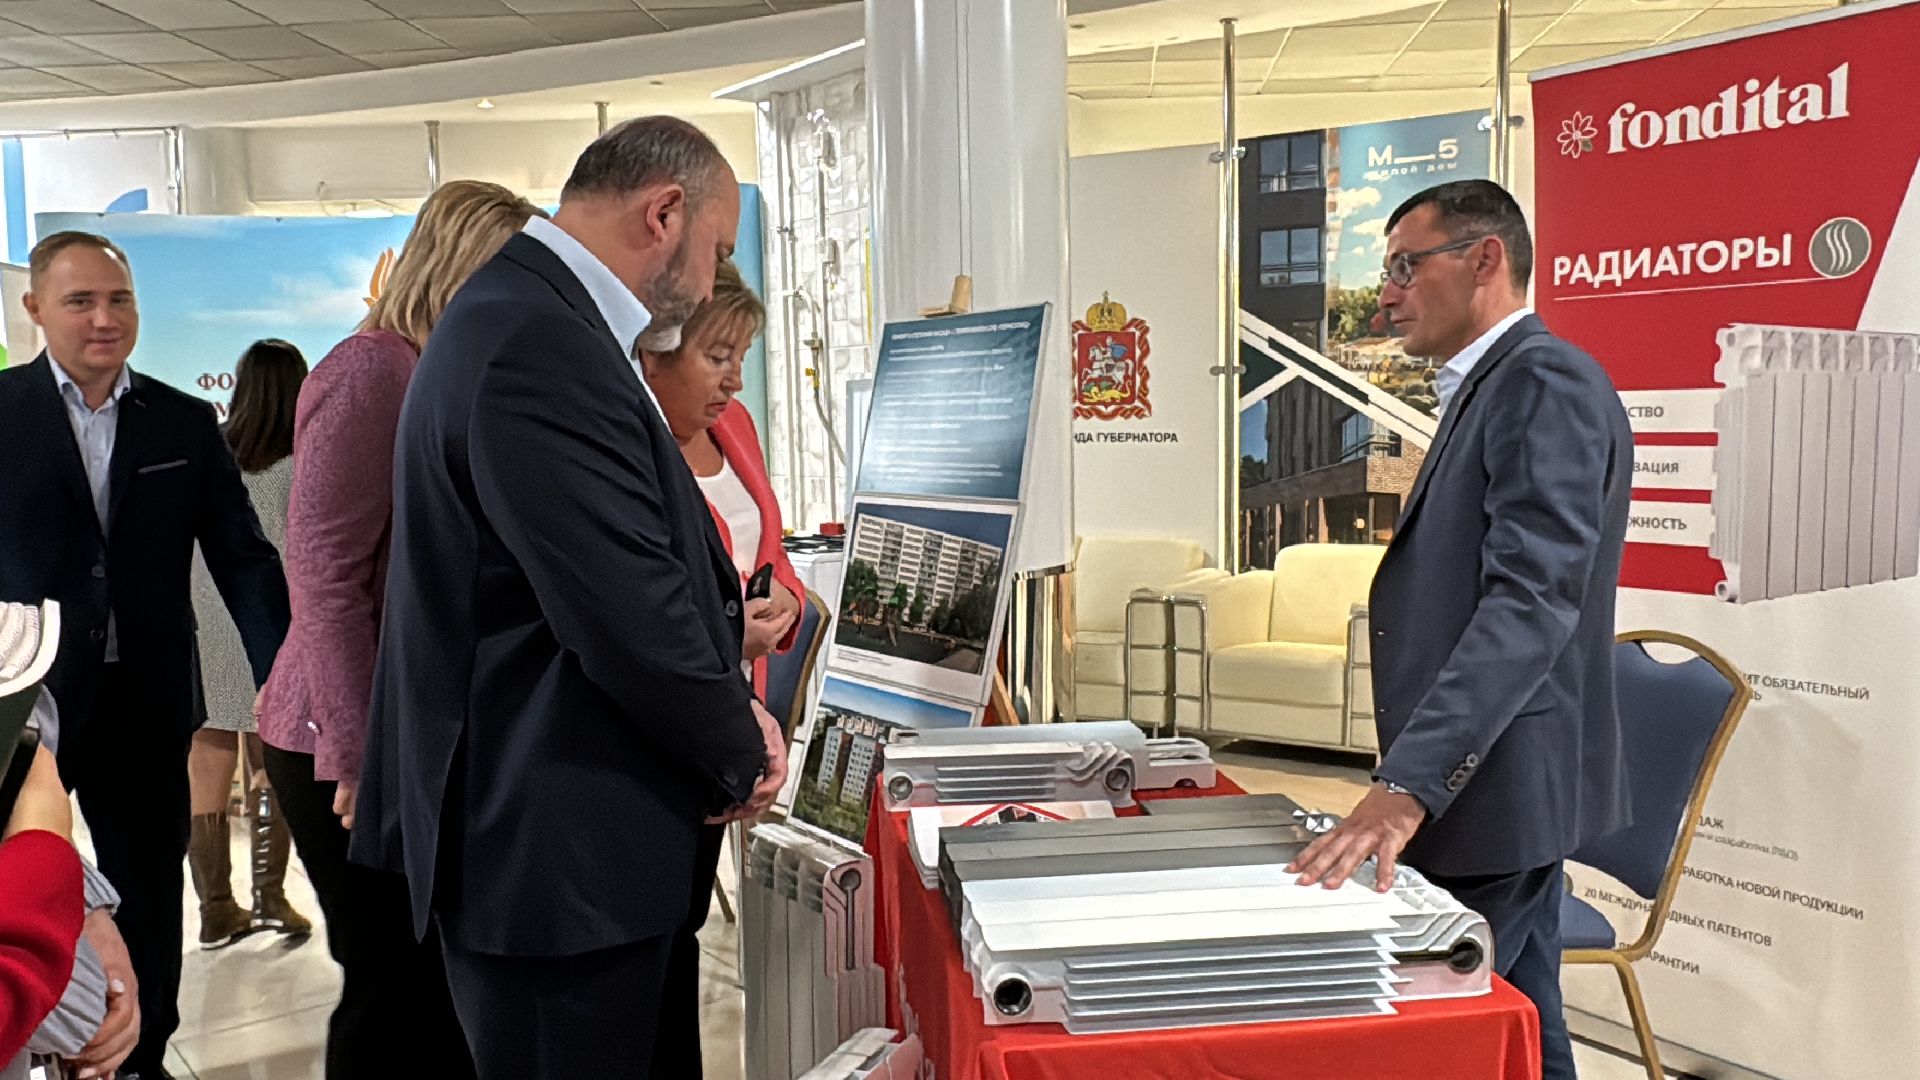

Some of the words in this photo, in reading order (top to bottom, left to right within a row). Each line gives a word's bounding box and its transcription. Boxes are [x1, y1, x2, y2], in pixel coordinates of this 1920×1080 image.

[1606, 61, 1850, 154] fondital
[1553, 233, 1792, 289] РАДИАТОРЫ
[1625, 405, 1665, 418] СТВО
[1096, 432, 1179, 444] ГУБЕРНАТОРА
[1761, 674, 1870, 700] ОБЯЗАТЕЛЬНЫЙ
[1735, 879, 1781, 900] НОВОЙ
[1782, 889, 1865, 920] ПРОДУКЦИИ
[1706, 919, 1772, 948] ПАТЕНТОВ
